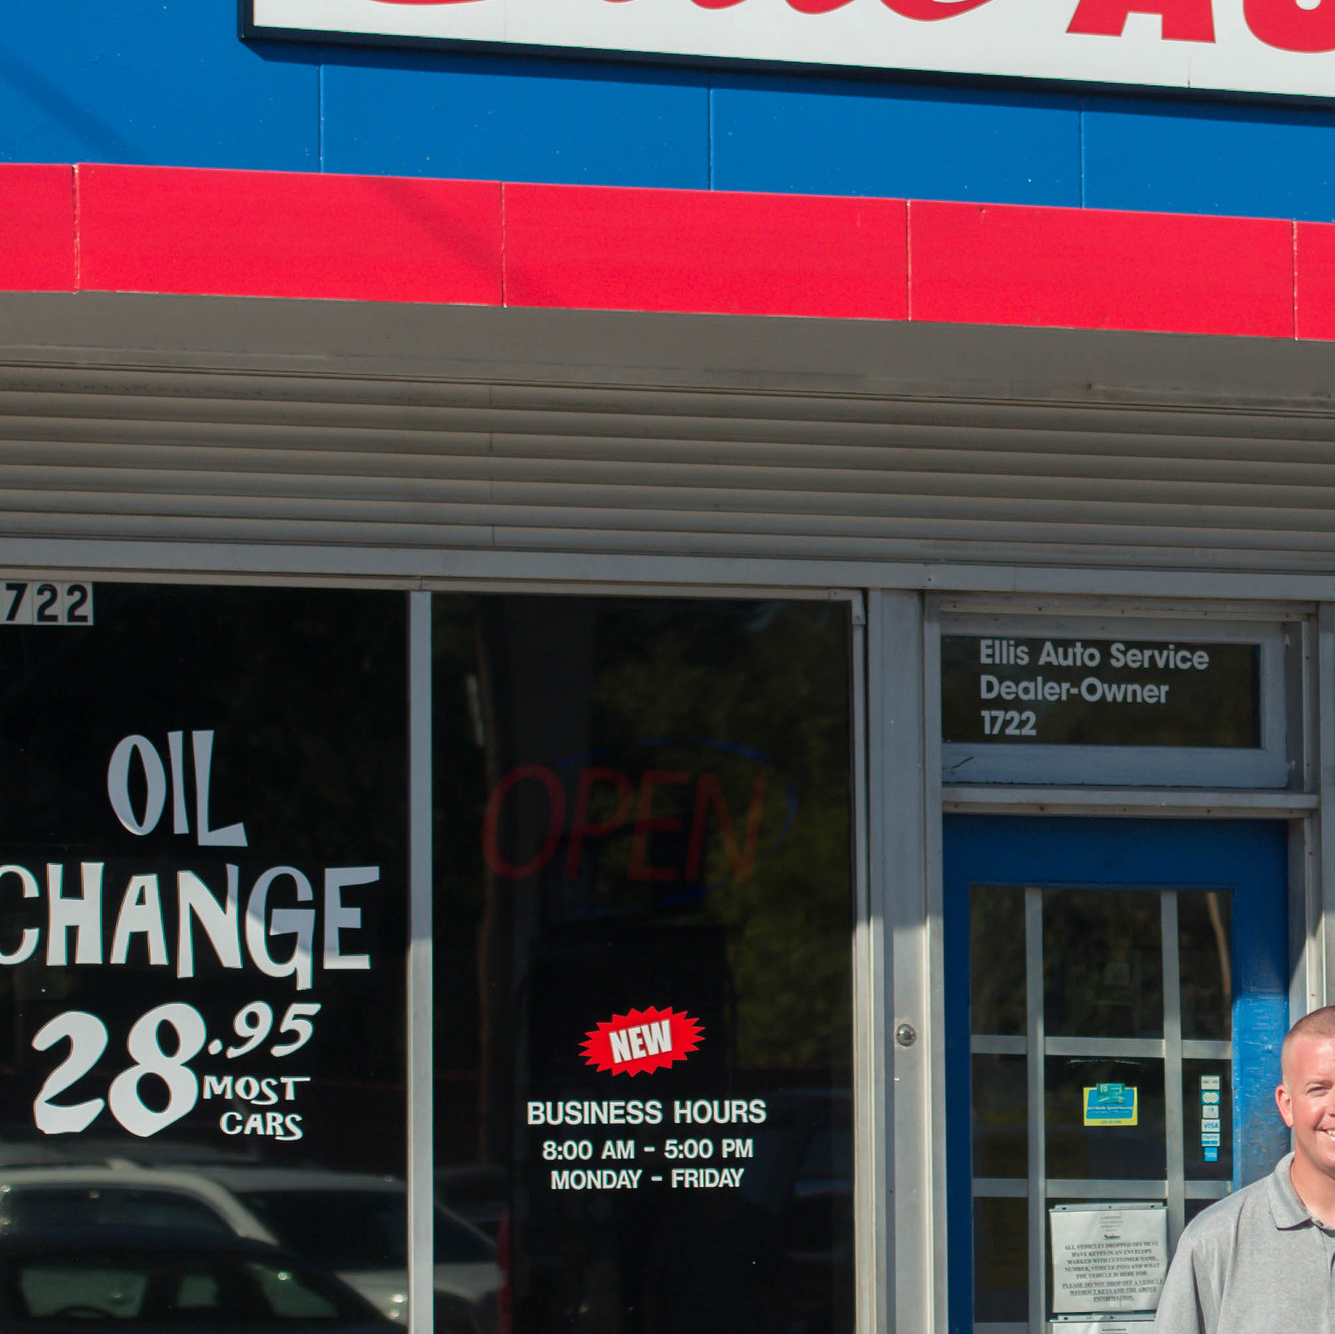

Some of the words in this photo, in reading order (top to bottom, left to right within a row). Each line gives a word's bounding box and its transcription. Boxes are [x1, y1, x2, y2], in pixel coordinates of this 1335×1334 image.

[5, 583, 89, 622] 722
[979, 639, 1029, 665] Ellis
[1039, 642, 1100, 667] Auto
[1110, 643, 1209, 670] Service
[980, 675, 1169, 704] Dealer-Owner
[981, 711, 1036, 736] 1722
[108, 730, 248, 847] OIL
[481, 764, 767, 884] OPEN
[609, 1019, 672, 1064] NEW
[202, 1076, 310, 1105] MOST
[220, 1113, 302, 1140] CARS
[527, 1100, 662, 1125] BUSINESS
[673, 1099, 767, 1123] HOURS
[542, 1140, 592, 1160] 8:00
[601, 1140, 635, 1159] AM
[665, 1139, 713, 1159] 5:00
[722, 1139, 753, 1158] PM
[551, 1170, 642, 1189] MONDAY
[672, 1169, 744, 1188] FRIDAY
